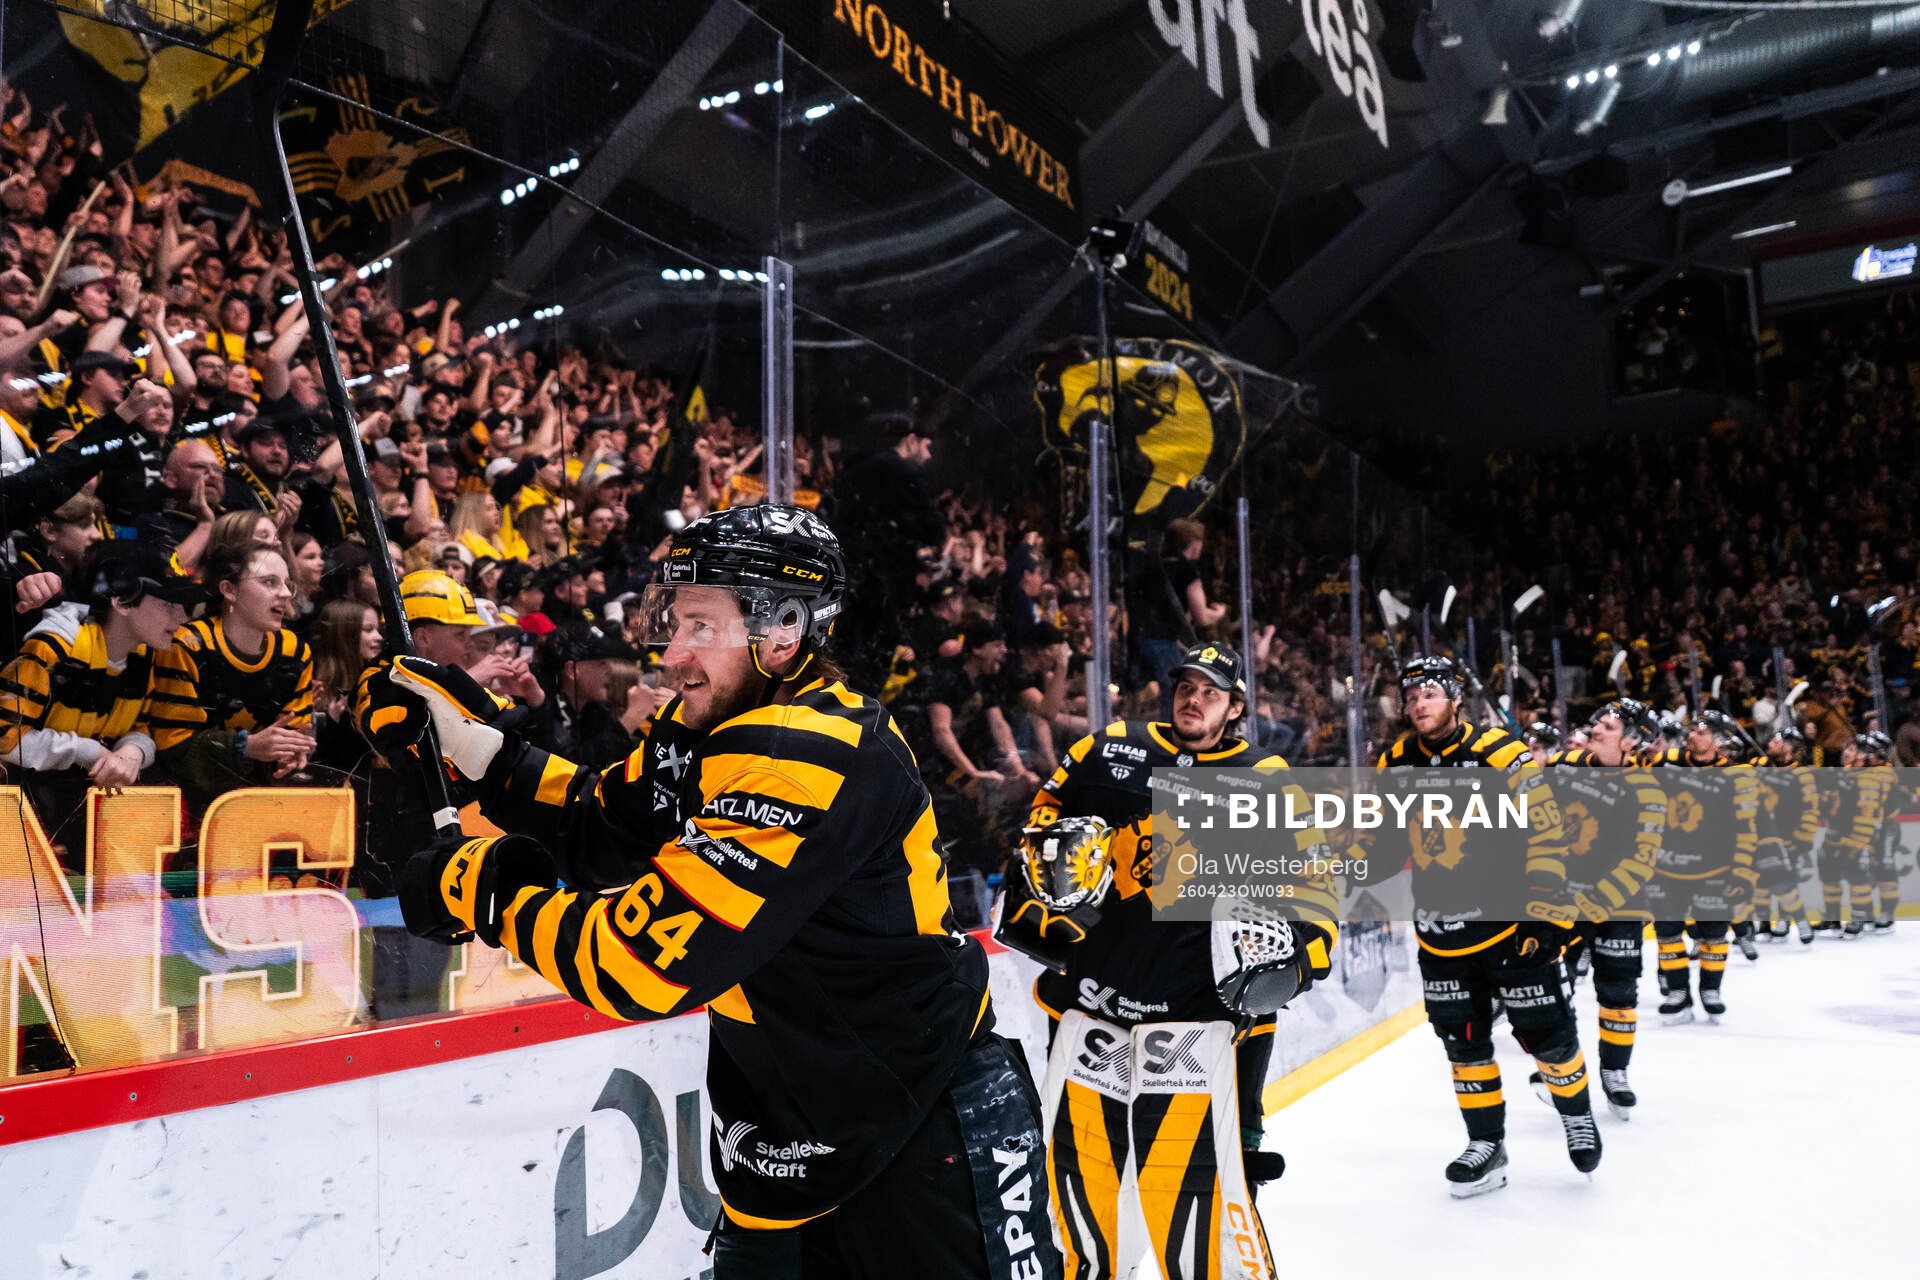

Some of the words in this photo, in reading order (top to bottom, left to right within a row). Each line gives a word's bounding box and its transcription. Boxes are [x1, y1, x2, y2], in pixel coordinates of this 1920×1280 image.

[833, 0, 966, 120] NORTH
[968, 91, 1075, 210] POWER
[1145, 252, 1193, 321] 2024
[671, 547, 692, 557] CCM
[781, 565, 823, 582] CCM
[1216, 773, 1262, 790] engcon
[1528, 799, 1562, 832] 96
[702, 846, 726, 866] Kraft
[711, 837, 758, 871] Skellefteå
[615, 872, 704, 970] 64
[1117, 996, 1169, 1013] Skellefteå
[1117, 1006, 1144, 1021] Kraft
[1073, 1069, 1111, 1089] Skellefteå
[1142, 1079, 1184, 1088] Skellefteå
[1185, 1079, 1208, 1088] Kraft
[1111, 1085, 1130, 1097] Kraf
[756, 1158, 807, 1179] Kraft
